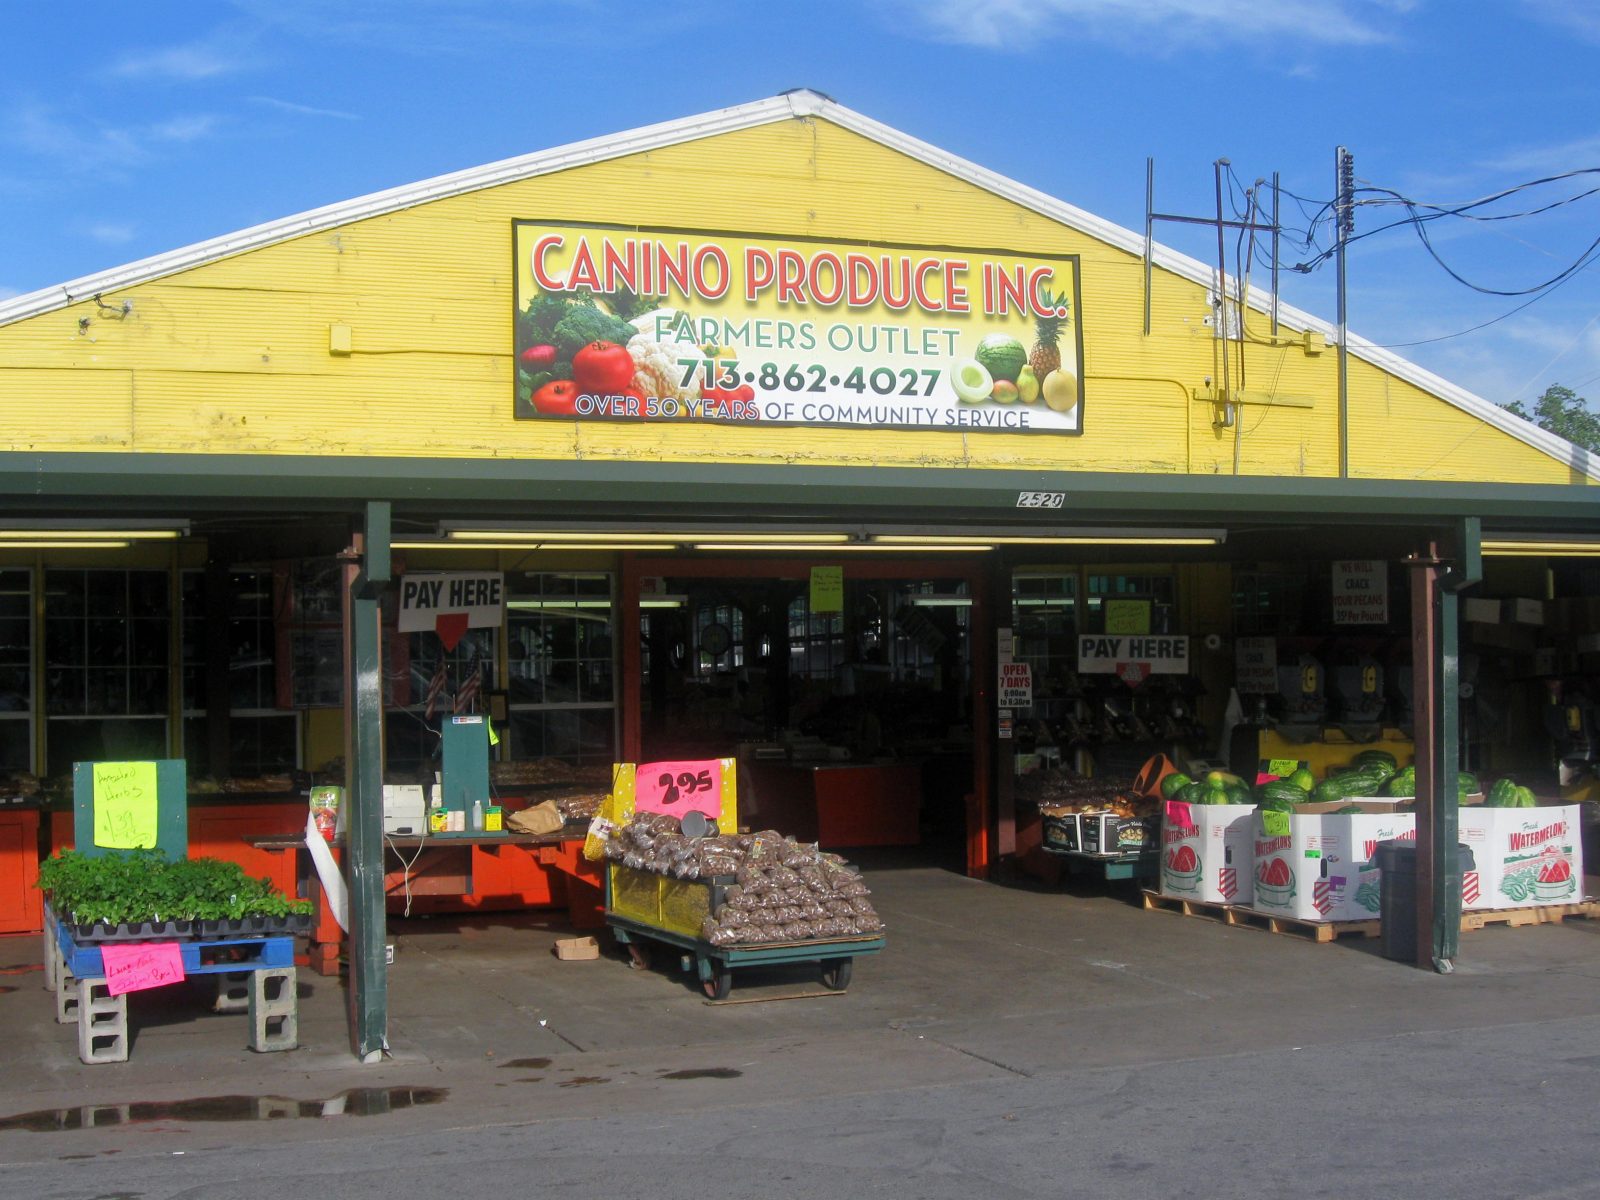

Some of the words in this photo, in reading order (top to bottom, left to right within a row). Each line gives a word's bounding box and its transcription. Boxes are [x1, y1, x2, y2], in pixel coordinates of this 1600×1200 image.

[532, 233, 730, 300] CANINO
[744, 247, 971, 314] PRODUCE
[983, 261, 1068, 319] INC.
[655, 315, 816, 350] FARMERS
[827, 323, 960, 356] OUTLET
[575, 395, 640, 417] OVER
[646, 398, 679, 418] 50
[686, 398, 761, 420] YEARS
[765, 402, 795, 421] OF
[802, 403, 939, 425] COMMUNITY
[945, 408, 1030, 428] SERVICE
[1018, 493, 1063, 507] 2520
[403, 580, 443, 609] PAY
[449, 578, 501, 608] HERE
[1345, 578, 1370, 590] CRACK
[1081, 639, 1121, 658] PAY
[1129, 639, 1185, 659] HERE
[1003, 664, 1027, 676] OPEN
[1000, 677, 1005, 688] 7
[1007, 676, 1031, 688] DAYS
